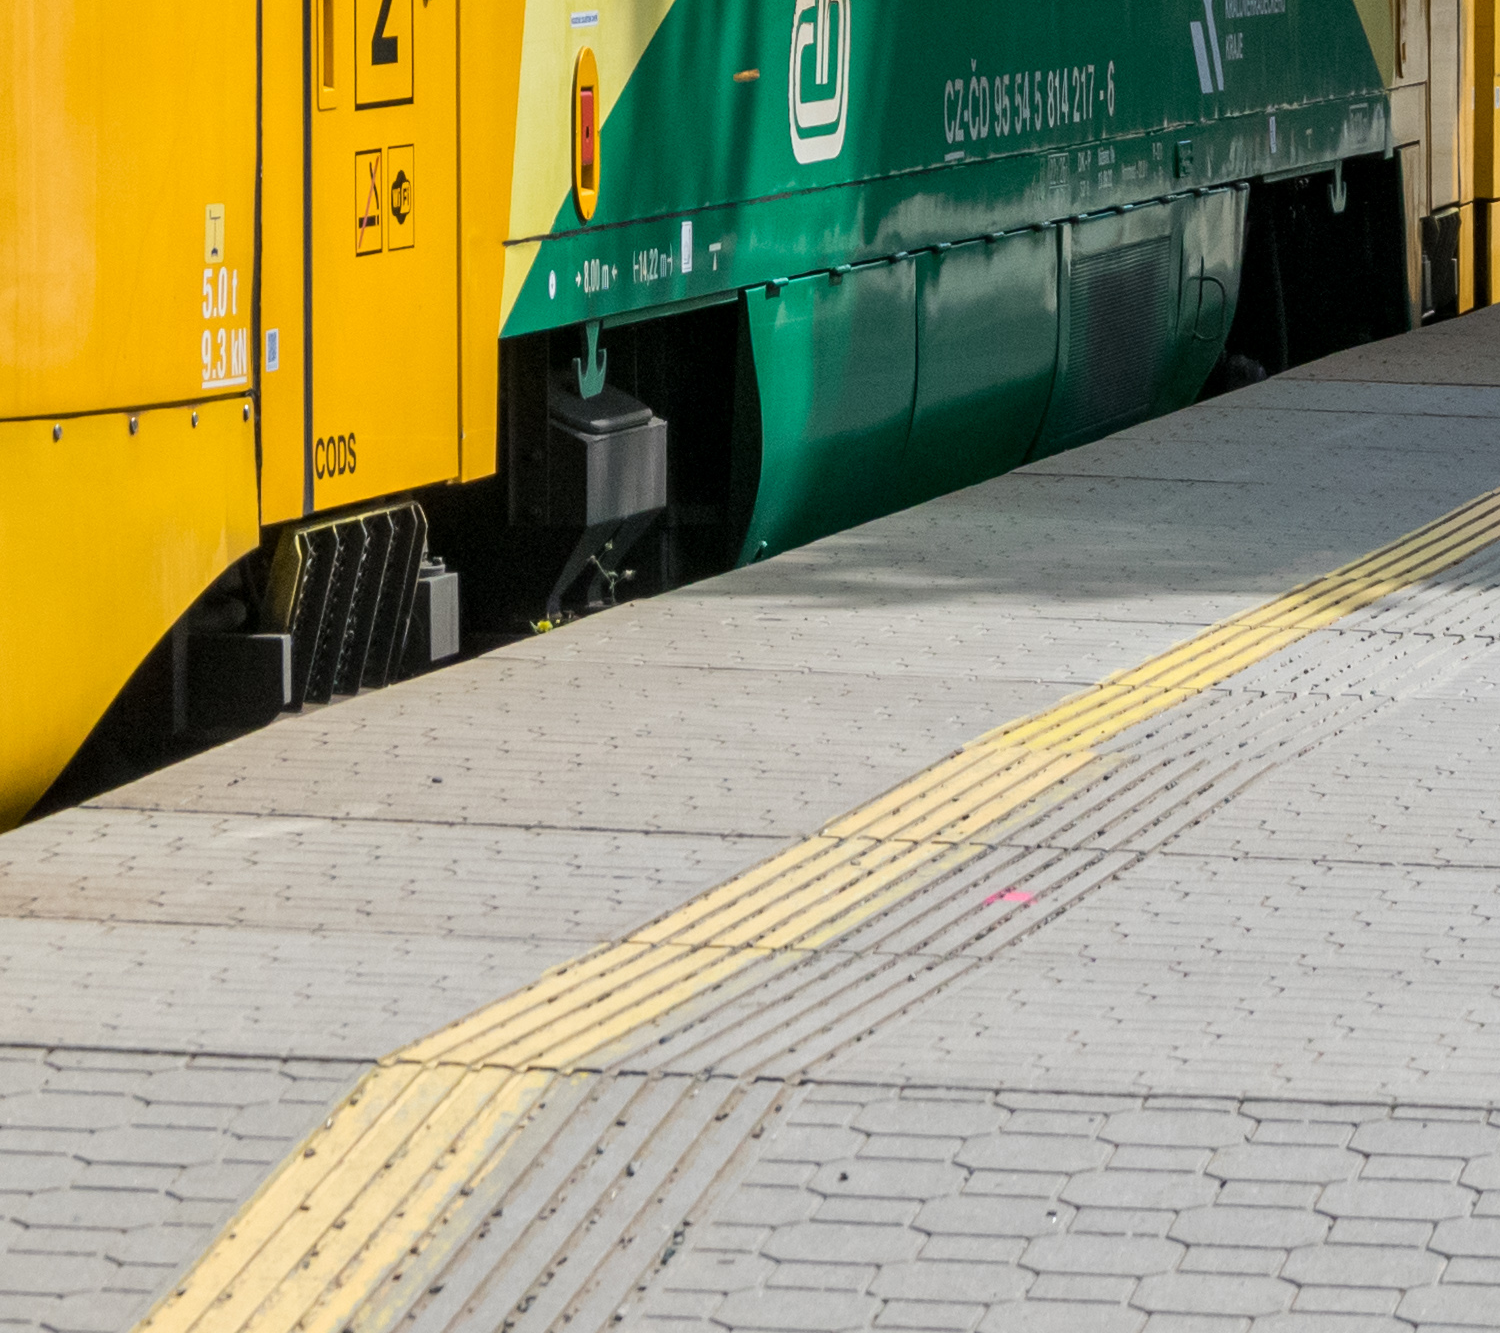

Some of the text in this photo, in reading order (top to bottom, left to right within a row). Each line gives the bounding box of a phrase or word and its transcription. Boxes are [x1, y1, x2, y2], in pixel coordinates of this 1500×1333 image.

[943, 58, 989, 144] CZ-ČD
[995, 73, 1011, 137] 95
[1014, 71, 1030, 134] 54
[1034, 71, 1043, 131] 5
[1047, 67, 1069, 128] 814
[1072, 64, 1095, 122] 217
[202, 267, 238, 320] 5.0 t
[583, 258, 600, 298] 8,00
[201, 328, 247, 380] 9.3 kN
[315, 432, 357, 480] CODS
